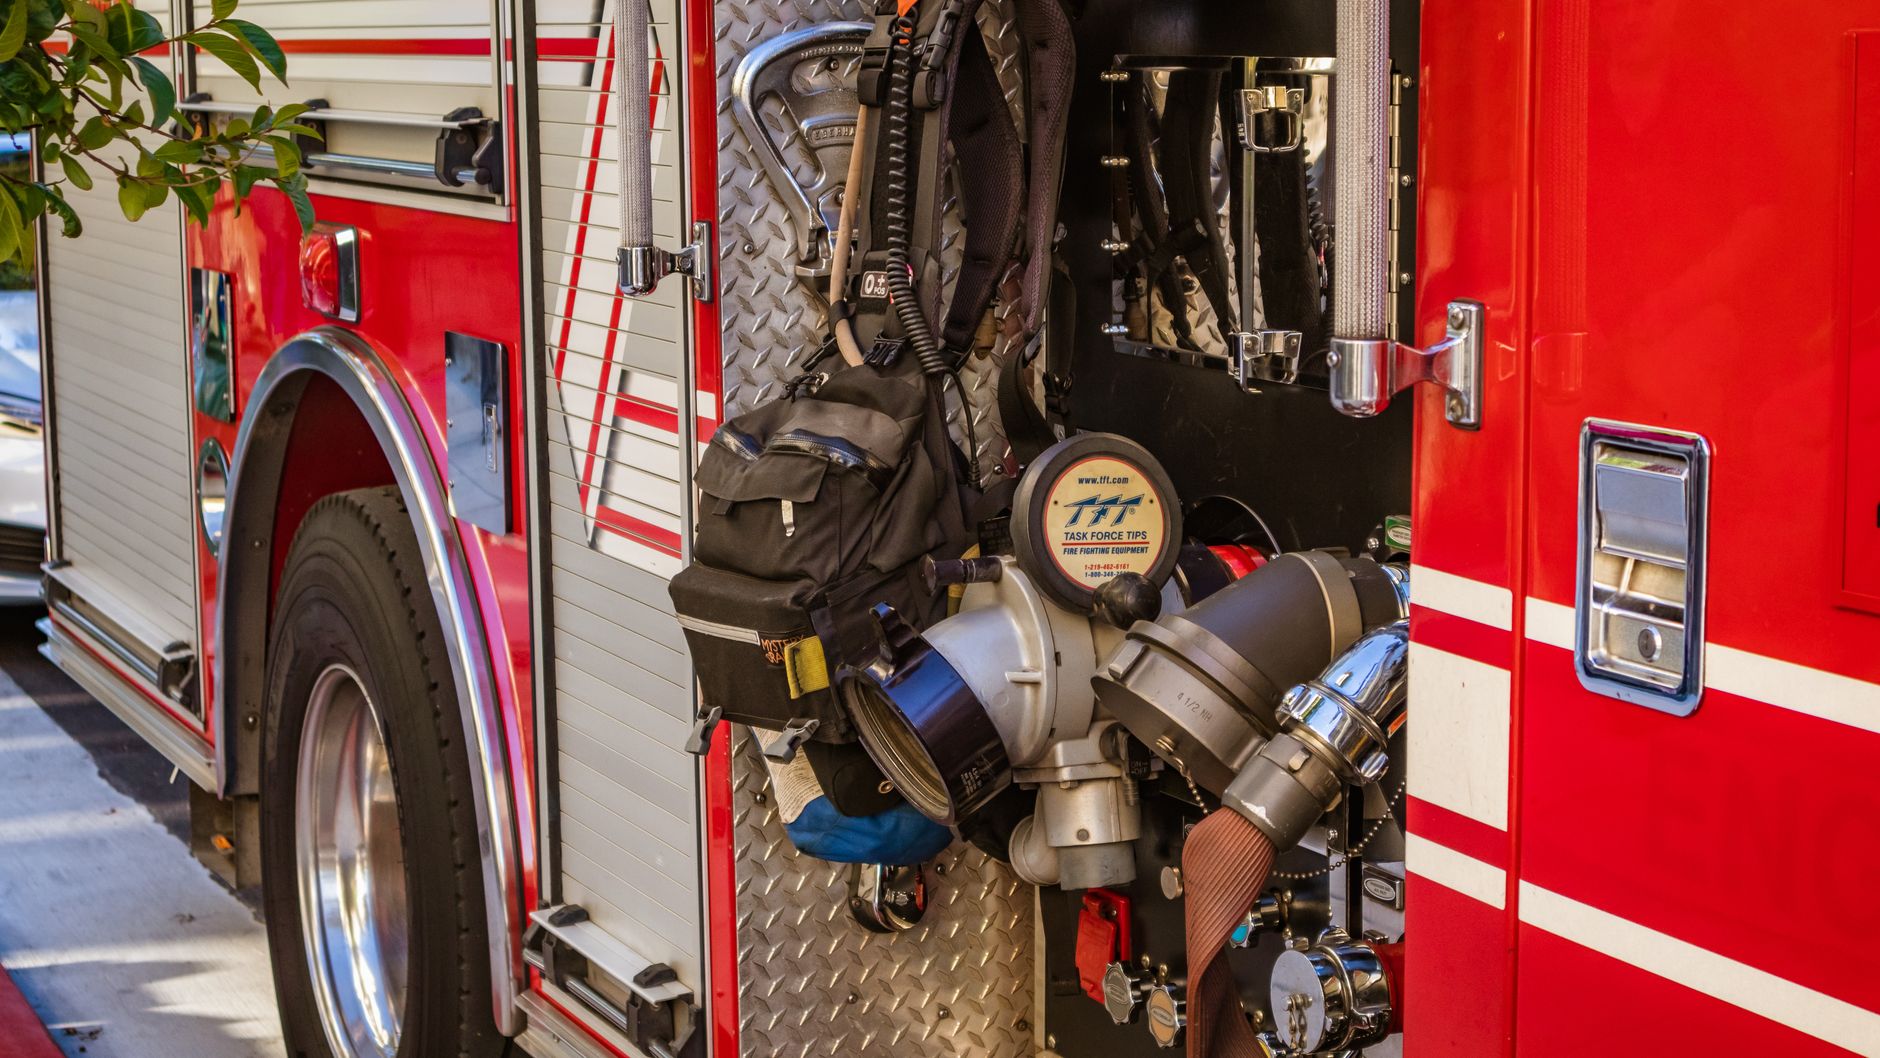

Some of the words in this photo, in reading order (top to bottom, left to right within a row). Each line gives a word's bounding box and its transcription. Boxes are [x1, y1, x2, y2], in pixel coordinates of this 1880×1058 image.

[1078, 476, 1129, 485] www.tft.com
[1063, 493, 1145, 528] TFT
[1064, 532, 1088, 541] TASK
[1090, 531, 1124, 541] FORCE
[1127, 530, 1147, 540] TIPS
[1063, 547, 1077, 555] FIRE
[1080, 547, 1110, 555] FIGHTING
[1111, 546, 1149, 554] EQUIPMENT
